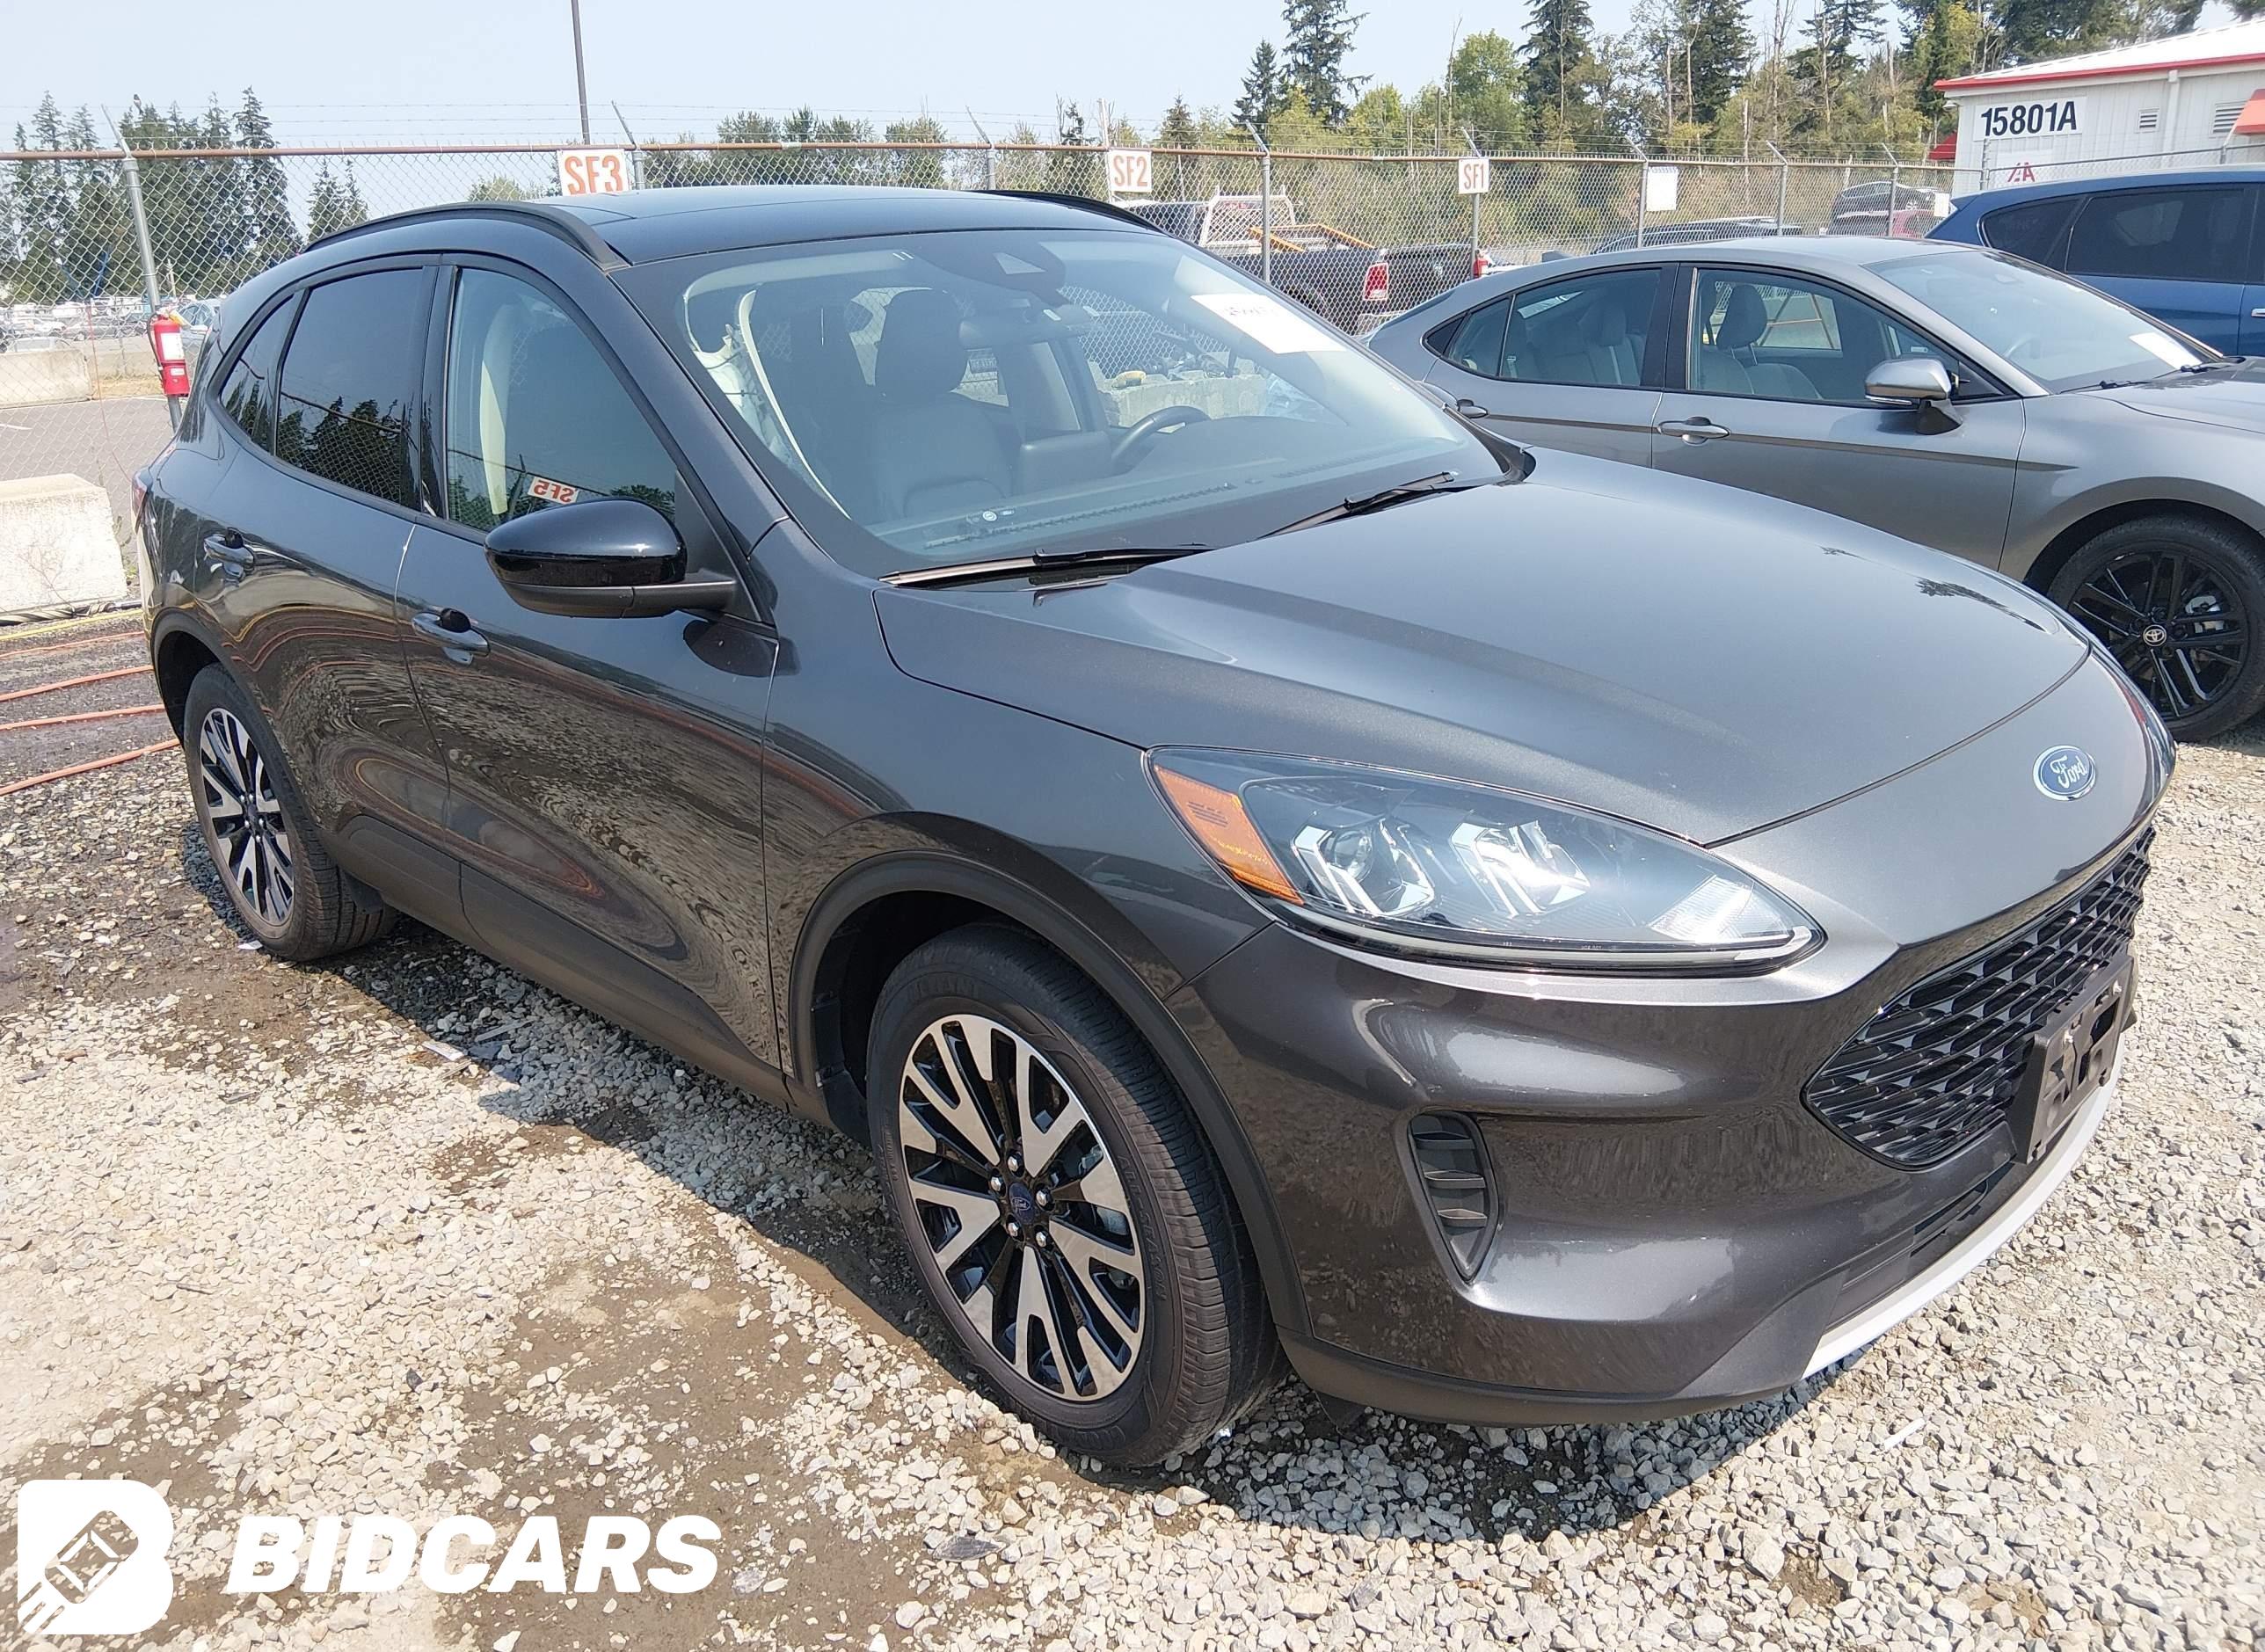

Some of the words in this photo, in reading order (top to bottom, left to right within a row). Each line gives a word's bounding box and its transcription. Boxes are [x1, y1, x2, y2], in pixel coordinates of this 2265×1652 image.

[1981, 101, 2077, 136] 15801A
[564, 155, 623, 195] SF3
[1113, 155, 1148, 186] SF2
[1463, 163, 1484, 190] SF1
[2050, 754, 2088, 789] Ford
